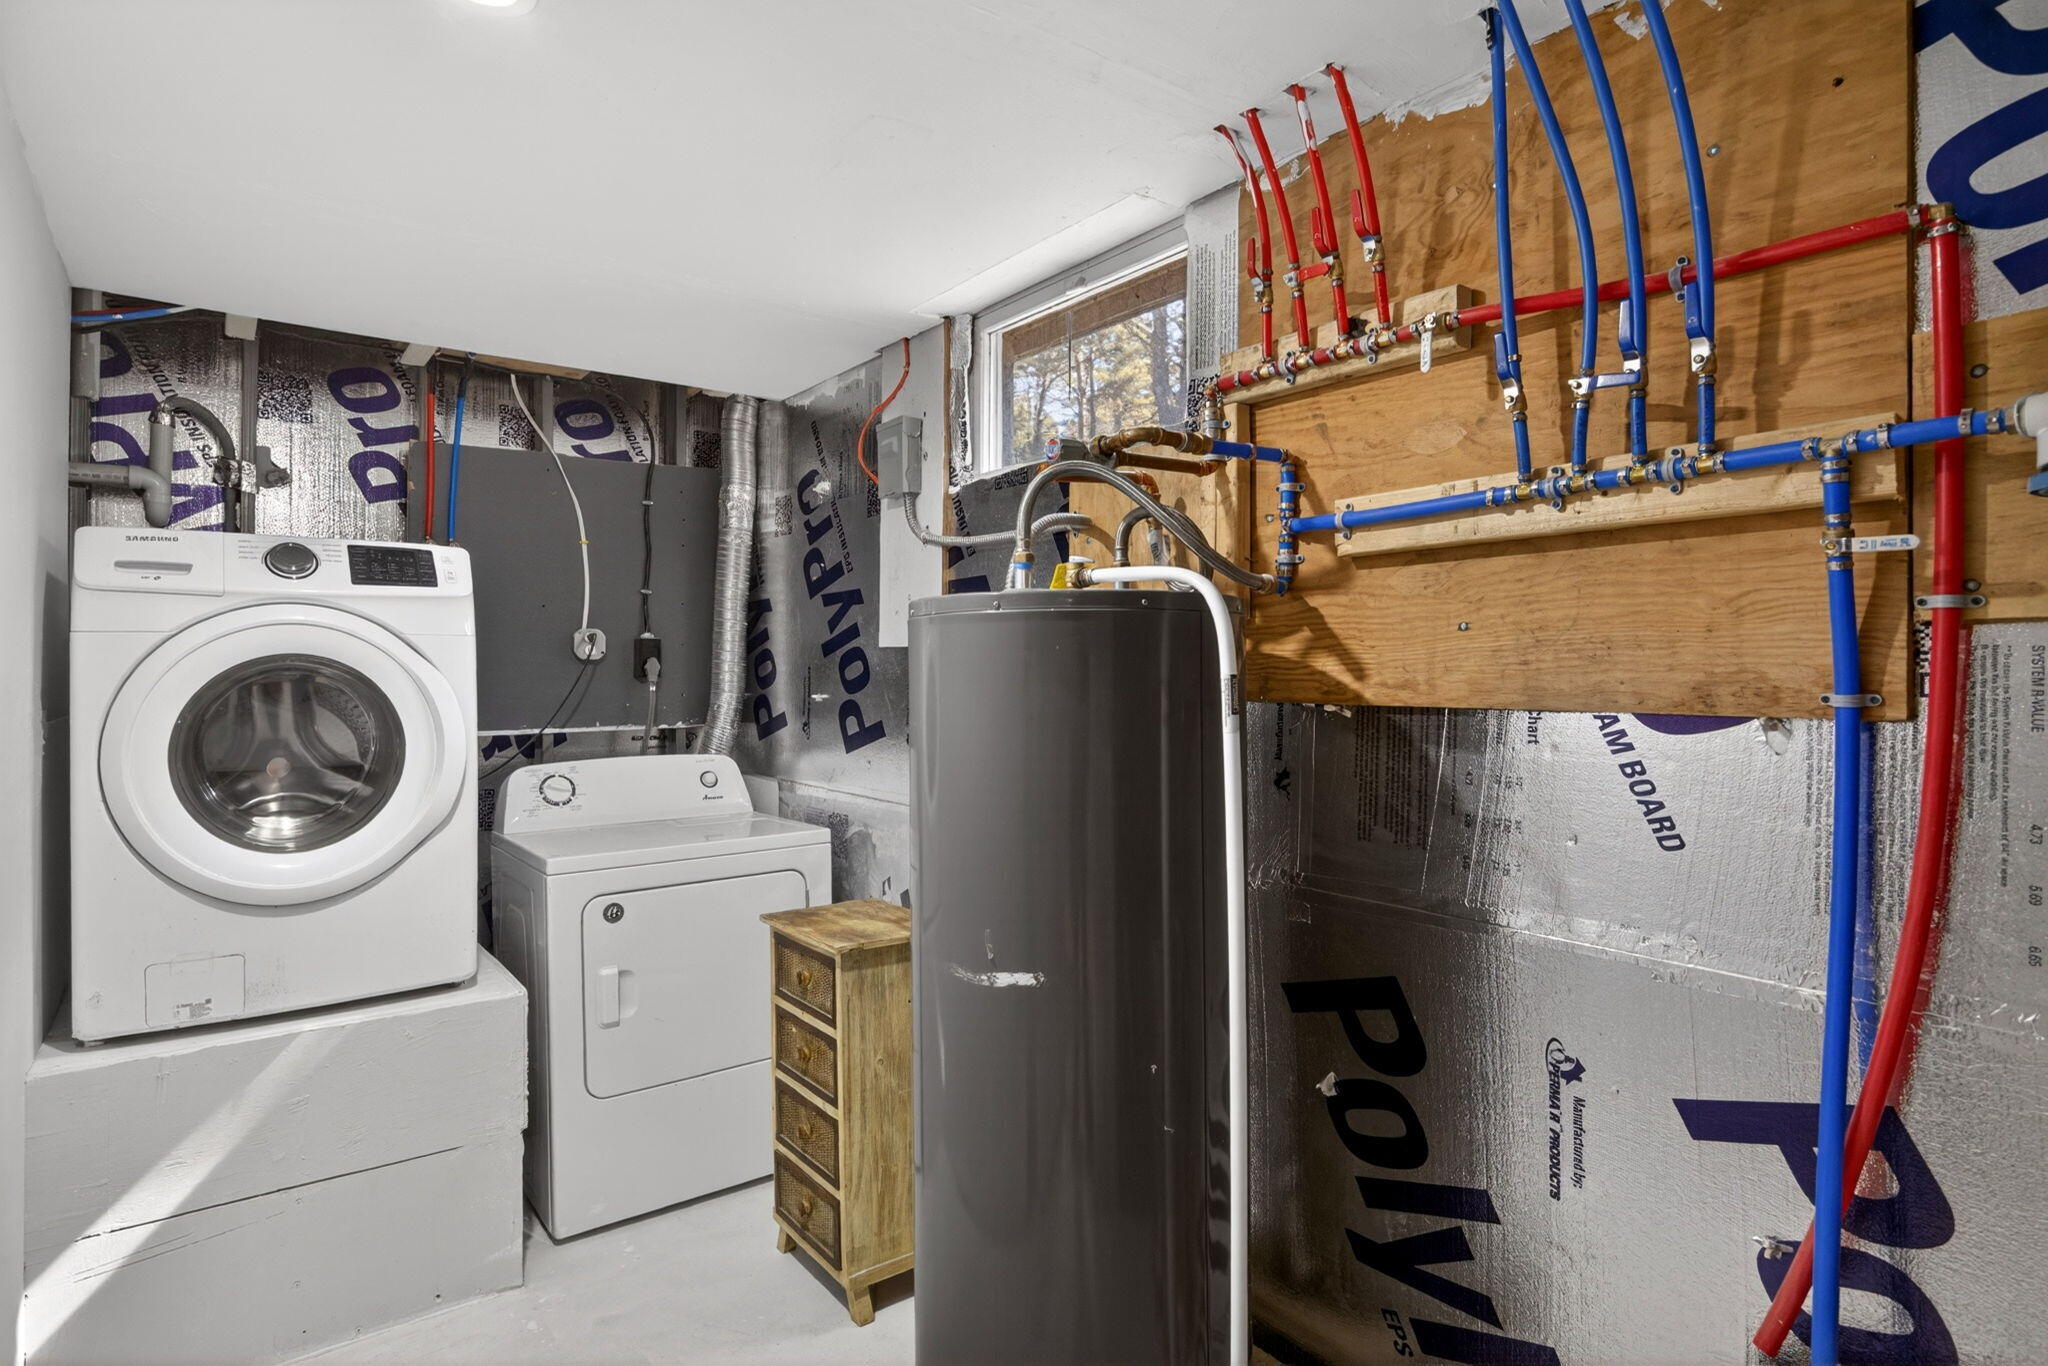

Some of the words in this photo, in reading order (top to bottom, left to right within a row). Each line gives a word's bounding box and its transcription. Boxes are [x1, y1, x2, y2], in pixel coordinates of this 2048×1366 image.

[124, 535, 179, 543] SAMSUNG
[2031, 644, 2046, 687] SYSTEM
[1618, 759, 1686, 852] BOARD
[2029, 824, 2043, 845] 4.73
[1549, 1062, 1562, 1108] PERMA
[1572, 1096, 1587, 1172] Manufactured
[1549, 1128, 1562, 1201] PRODUCTS
[1570, 1172, 1586, 1190] by:
[1380, 1308, 1415, 1359] EPS
